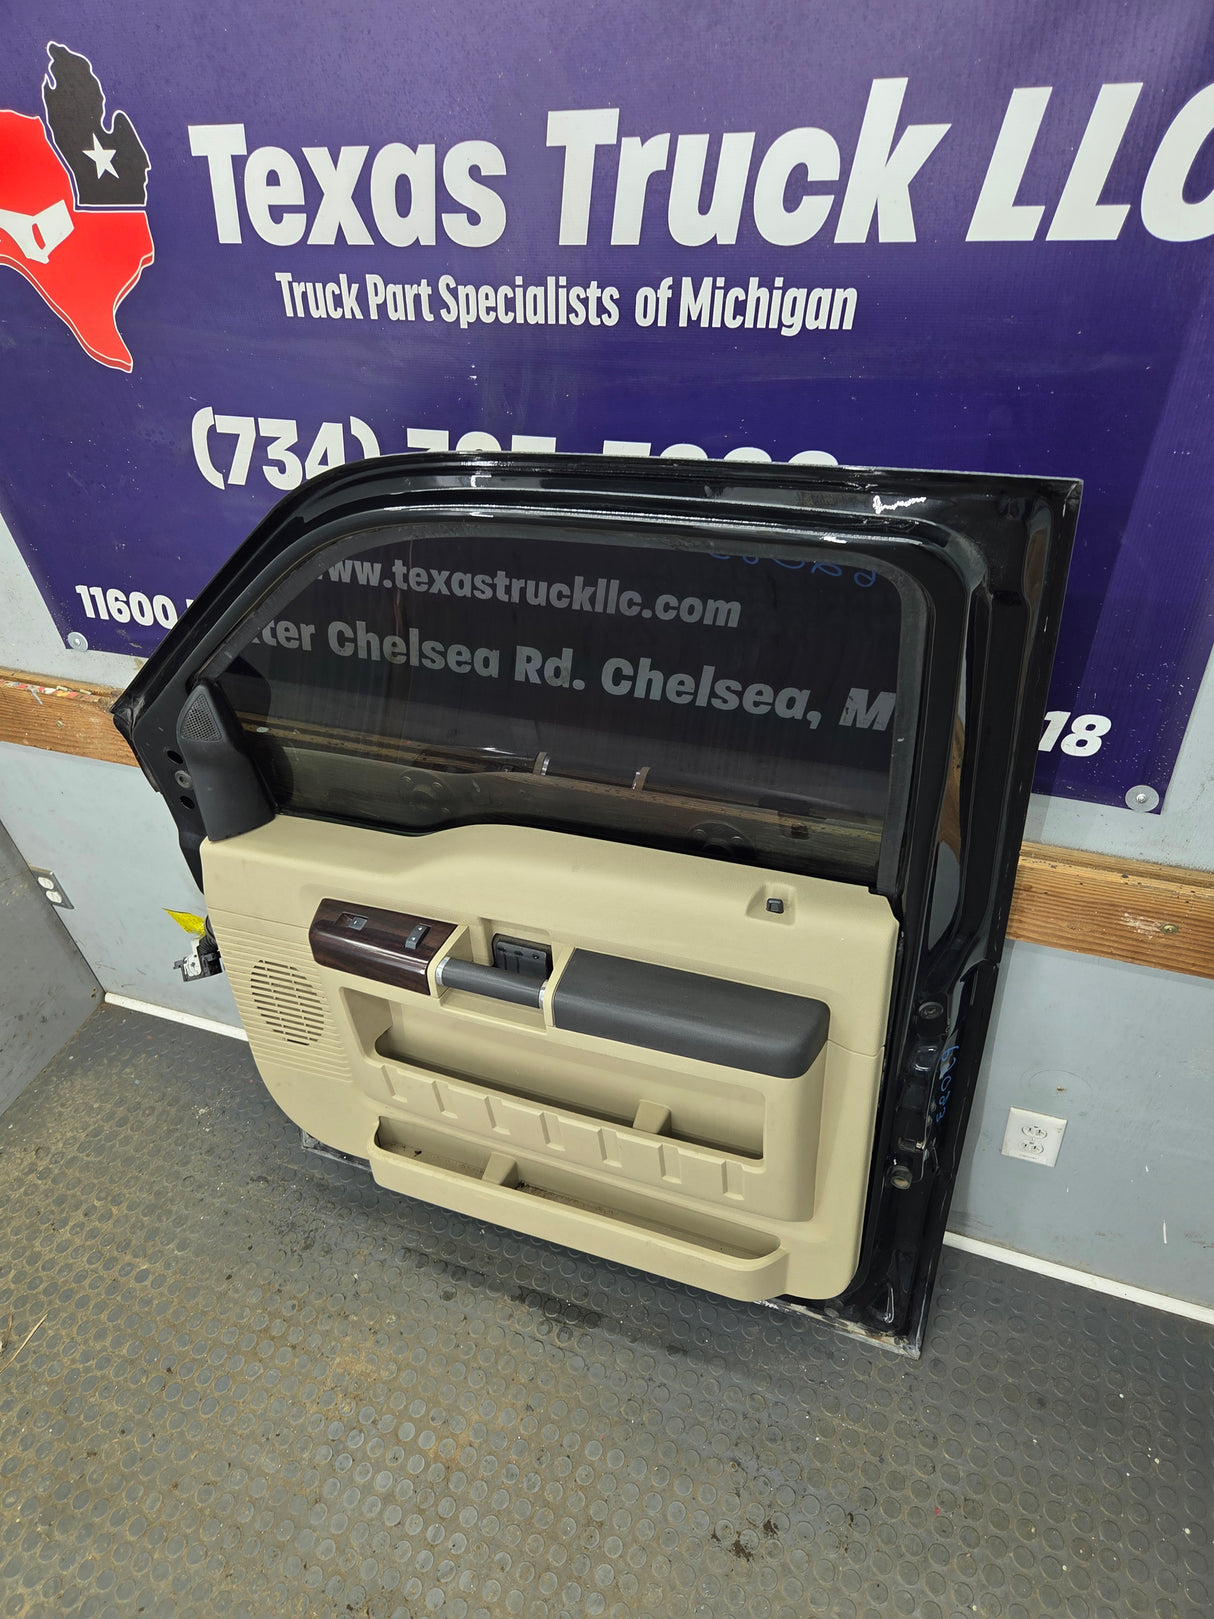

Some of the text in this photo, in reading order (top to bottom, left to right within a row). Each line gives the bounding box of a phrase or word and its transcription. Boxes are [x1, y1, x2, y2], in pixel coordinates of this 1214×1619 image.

[187, 77, 1214, 247] Texas Truck LLC
[275, 272, 858, 337] Truck Part Specialists of Michigan
[317, 560, 742, 628] ww.texastruckllc.com
[75, 584, 1112, 757] 11600 ter Chelsea Rd. Chelsea, M 18
